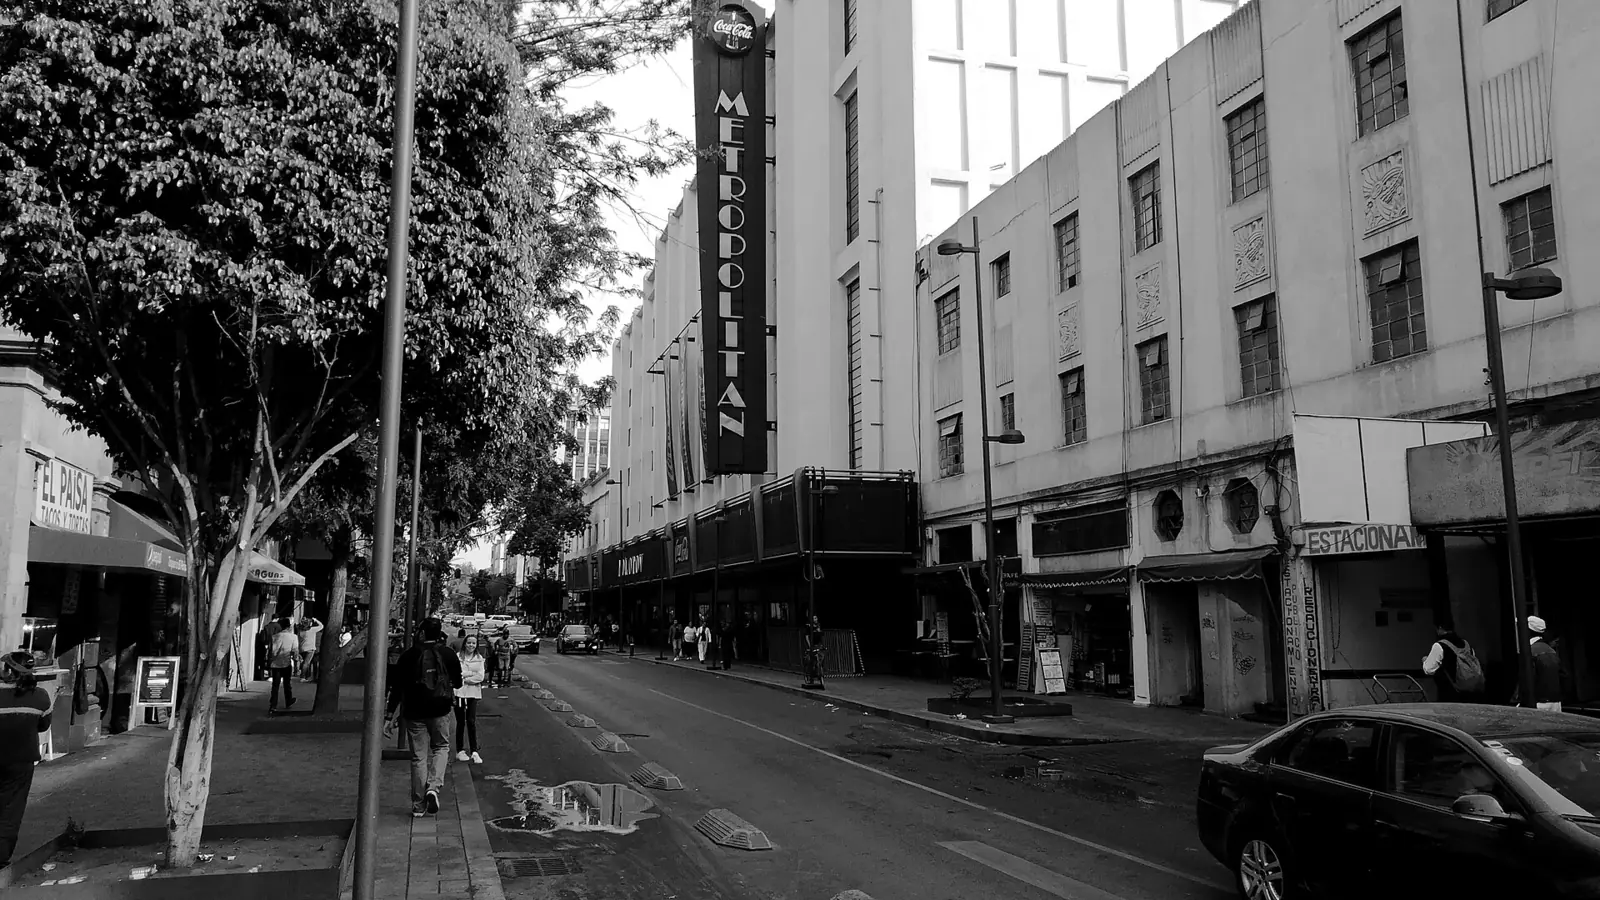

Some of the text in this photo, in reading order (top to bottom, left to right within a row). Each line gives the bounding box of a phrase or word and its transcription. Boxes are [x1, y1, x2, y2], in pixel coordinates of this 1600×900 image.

[713, 19, 754, 39] Coca-Cola
[714, 89, 749, 437] METROPOLITAN
[42, 460, 55, 503] EL
[41, 505, 89, 532] TACOS Y TORTAS
[1292, 584, 1300, 660] PUBLICO
